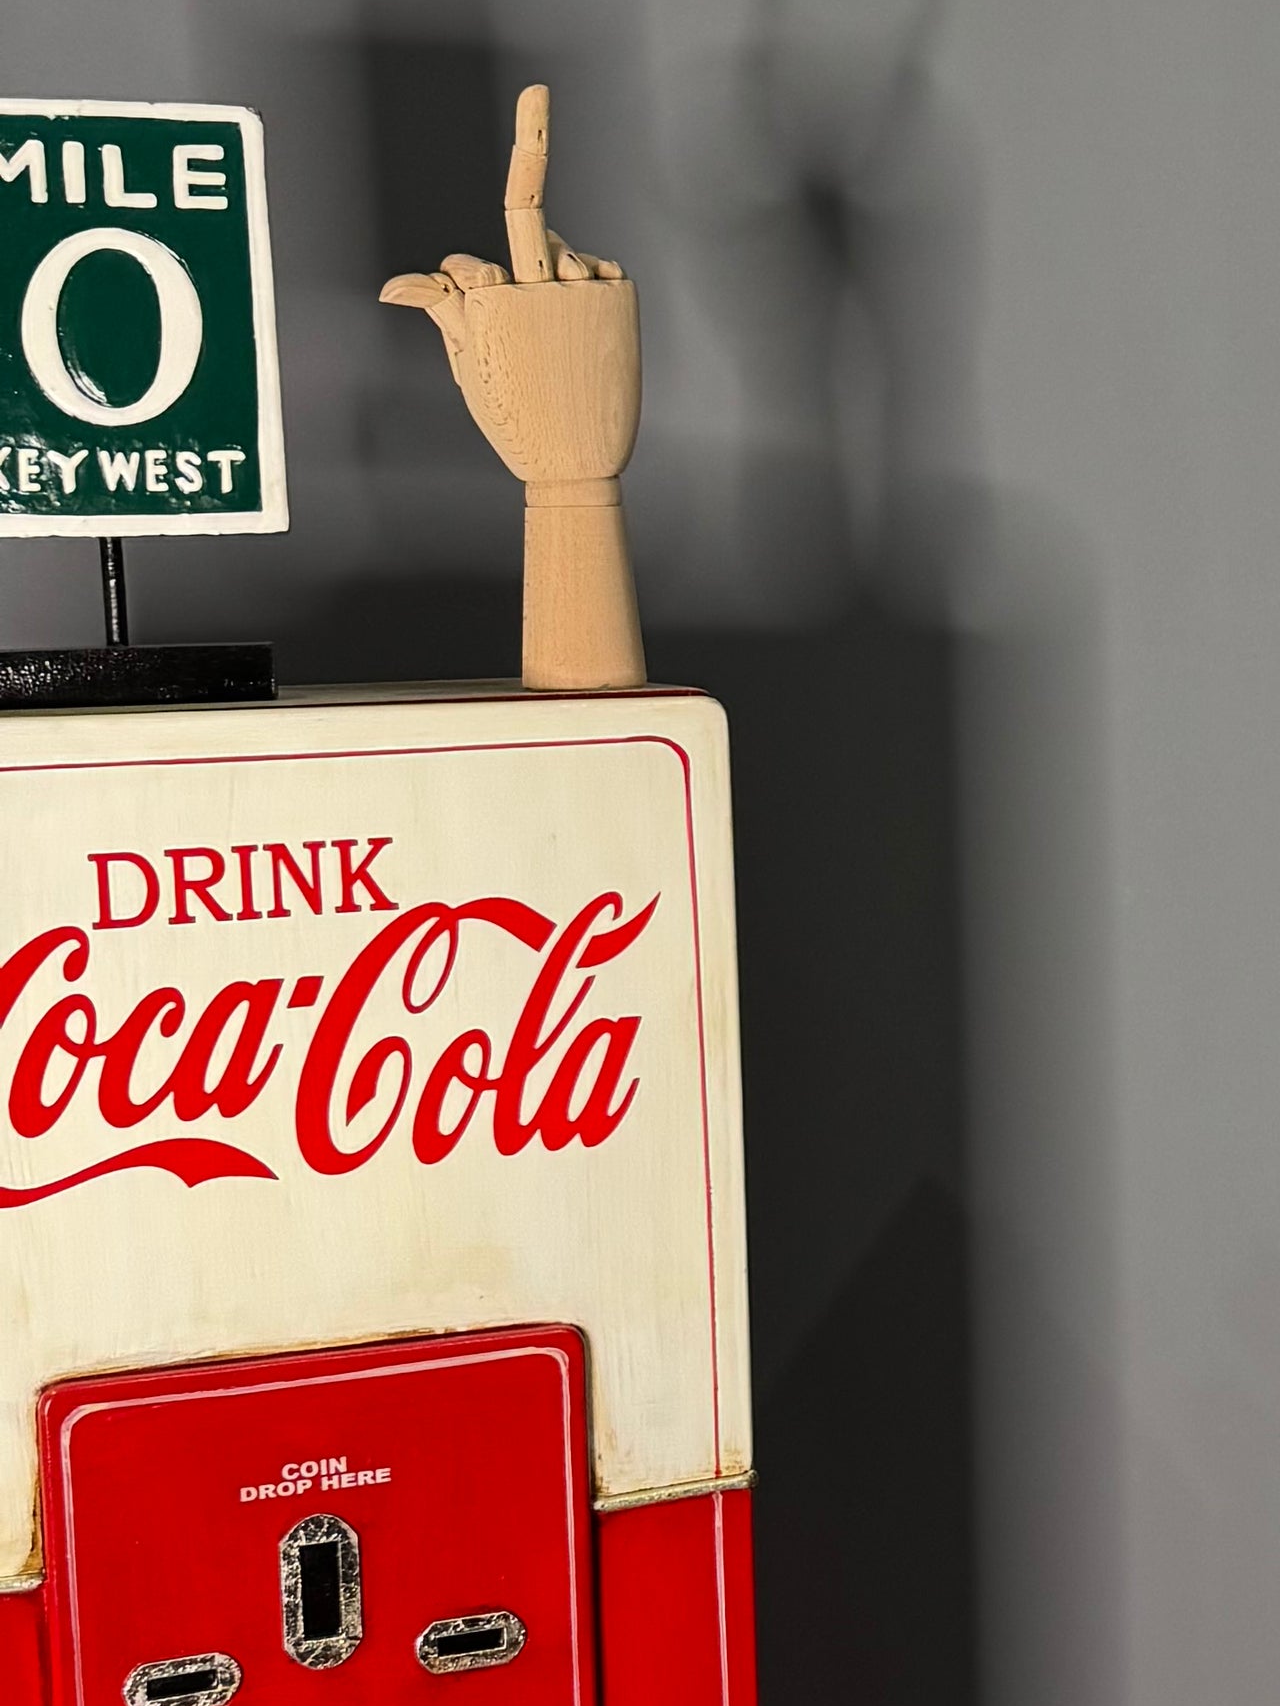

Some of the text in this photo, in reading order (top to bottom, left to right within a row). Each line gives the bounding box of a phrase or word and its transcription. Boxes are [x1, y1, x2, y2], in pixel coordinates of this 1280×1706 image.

[0, 139, 229, 210] MILE
[96, 448, 246, 494] WEST
[87, 837, 399, 930] DRINK
[239, 1467, 392, 1503] DROP HERE
[281, 1455, 348, 1481] COIN
